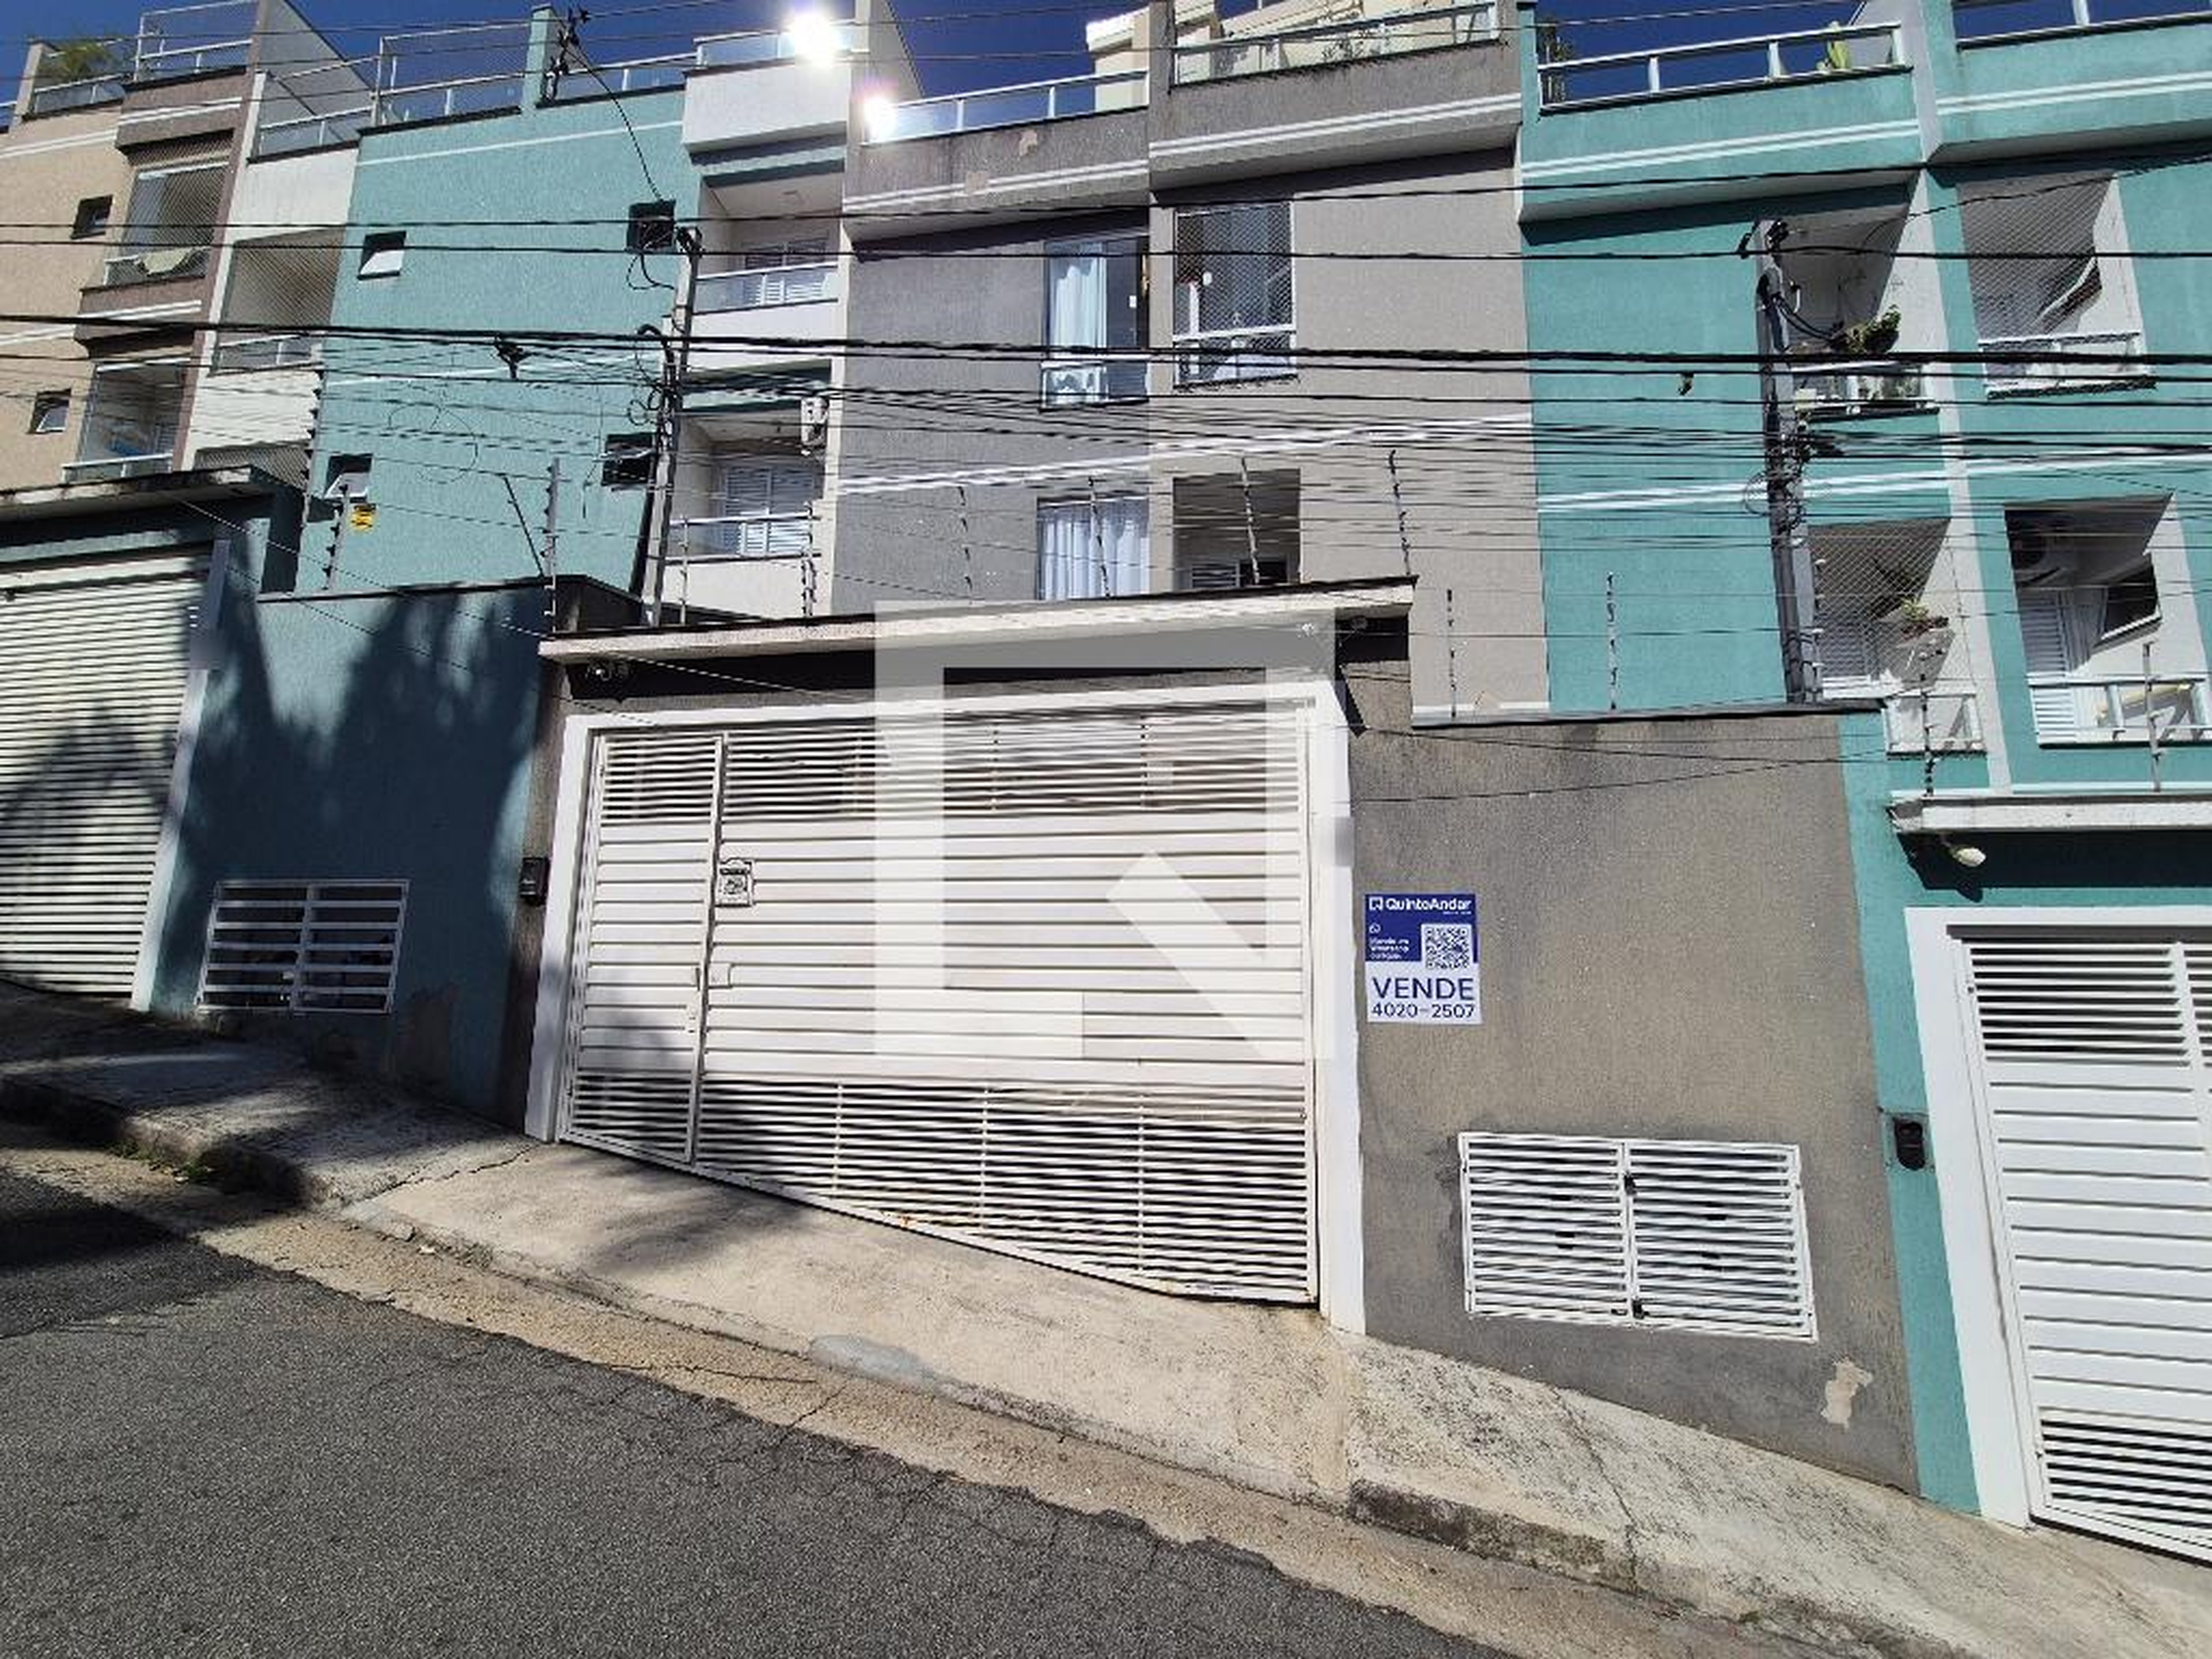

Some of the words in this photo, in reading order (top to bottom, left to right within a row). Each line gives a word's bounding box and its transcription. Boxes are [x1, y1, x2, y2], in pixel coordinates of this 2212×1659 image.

[1385, 897, 1472, 910] QuintoAndar
[1372, 978, 1474, 1000] VENDE
[1372, 1002, 1475, 1018] 4020-2507
